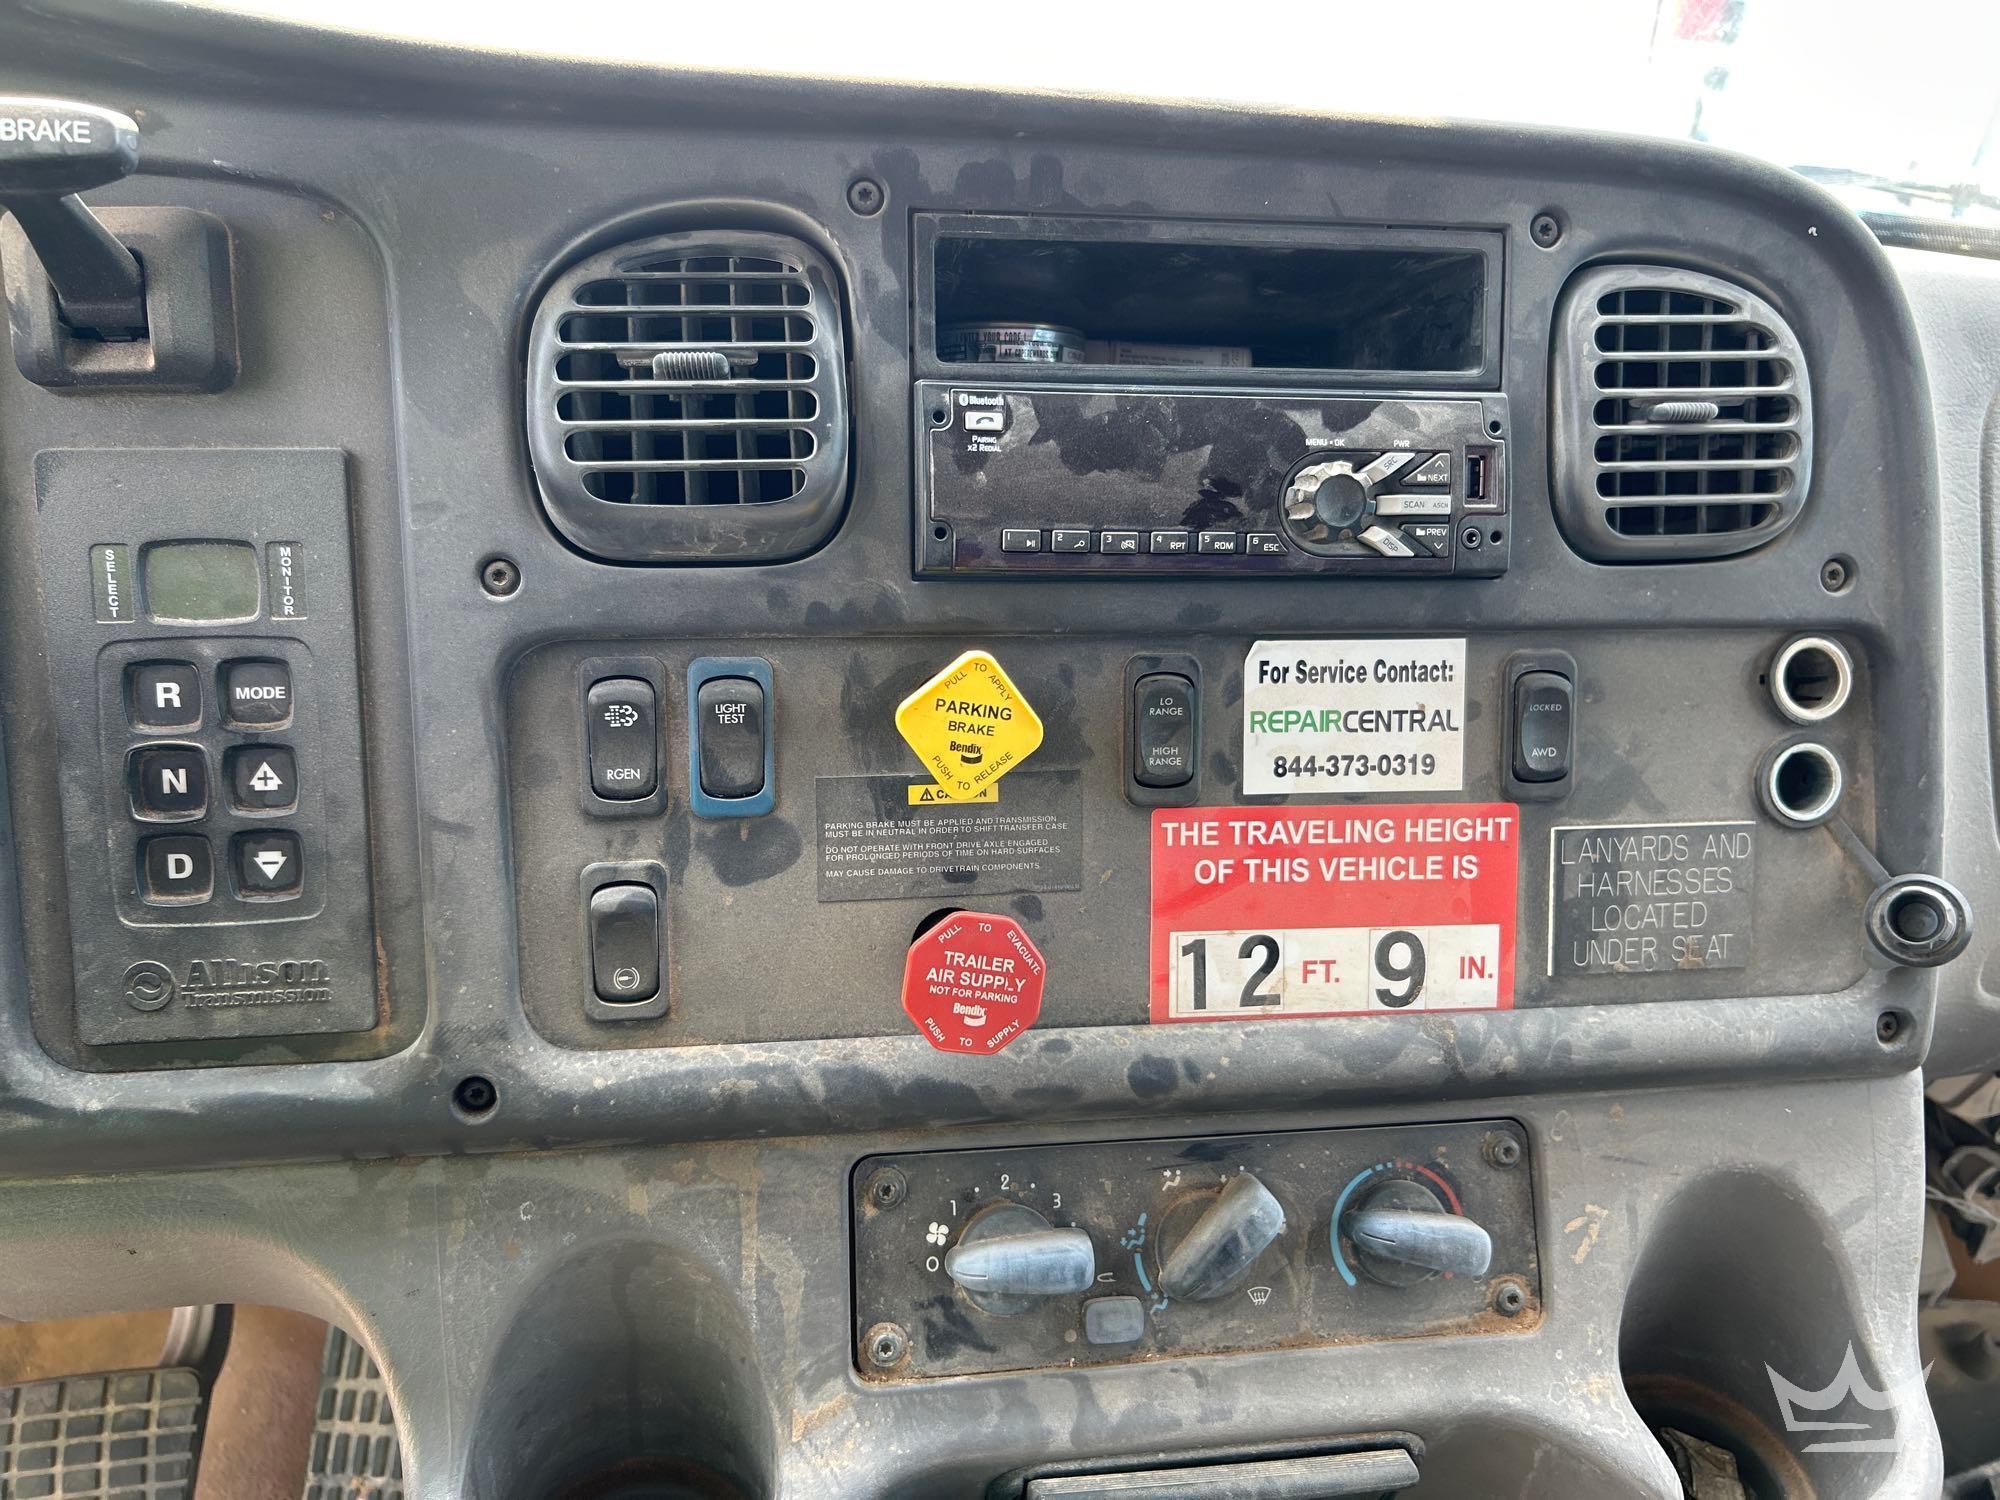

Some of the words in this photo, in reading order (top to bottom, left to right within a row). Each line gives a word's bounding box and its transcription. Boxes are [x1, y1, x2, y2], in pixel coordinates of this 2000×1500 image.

[0, 118, 91, 143] BRAKE
[1305, 438, 1327, 446] MENU
[1393, 440, 1410, 448] PWR
[1383, 456, 1398, 470] SRC
[1427, 474, 1448, 482] NEXT
[1404, 501, 1425, 509] SCAN
[1106, 535, 1112, 543] 3
[1426, 528, 1447, 536] PREV
[1156, 535, 1162, 543] 4
[1170, 542, 1186, 550] RPT
[1204, 535, 1210, 543] 5
[1214, 542, 1234, 550] RDM
[1252, 537, 1259, 545] 6
[1263, 543, 1279, 551] ESC
[1382, 538, 1398, 552] DISP
[105, 550, 119, 617] SELECT
[280, 547, 294, 615] MONITOR
[1259, 660, 1290, 684] For
[1295, 659, 1367, 684] Service
[1373, 659, 1454, 683] Contact:
[944, 671, 967, 689] PULL
[973, 663, 988, 672] TO
[988, 674, 1013, 701] APPLY
[156, 683, 182, 708] R
[236, 686, 286, 700] MODE
[715, 703, 747, 714] LIGHT
[935, 698, 1012, 721] PARKING
[1160, 697, 1173, 706] LO
[1529, 703, 1562, 711] LOCKED
[718, 714, 745, 724] TEST
[1149, 707, 1183, 716] RANGE
[948, 721, 995, 737] BRAKE
[1250, 709, 1459, 733] REPAIRCENTRAL
[950, 741, 982, 755] Bendix
[1153, 747, 1178, 756] HIGH
[1531, 747, 1557, 757] AWD
[1149, 757, 1182, 766] RANGE
[1273, 754, 1436, 778] 844-373-0319
[607, 769, 641, 780] RGEN
[932, 755, 954, 781] PUSH
[957, 781, 971, 791] TO
[974, 751, 1014, 784] RELEASE
[162, 769, 188, 794] N
[825, 822, 863, 830] PARKING
[866, 820, 895, 829] BRAKE
[898, 819, 921, 828] MUST
[924, 819, 935, 827] BE
[937, 818, 973, 826] APPLIED
[976, 817, 993, 825] AND
[995, 815, 1057, 824] TRANSMISSION
[825, 830, 849, 838] MUST
[851, 829, 863, 837] BE
[866, 828, 874, 836] IN
[877, 828, 915, 836] NEUTRAL
[918, 827, 927, 835] IN
[929, 826, 959, 834] ORDER
[961, 825, 972, 833] TO
[974, 824, 998, 832] SHIFT
[999, 823, 1044, 832] TRANSFER
[1045, 822, 1068, 830] CASE
[1161, 821, 1219, 847] THE
[1228, 819, 1395, 846] TRAVELING
[1405, 817, 1512, 843] HEIGHT
[825, 846, 838, 854] DO
[840, 845, 858, 853] NOT
[860, 844, 900, 853] OPERATE
[902, 843, 923, 851] WITH
[926, 842, 953, 850] FRONT
[956, 841, 981, 849] DRIVE
[983, 840, 1005, 848] AXLE
[1008, 839, 1048, 847] ENGAGED
[825, 854, 844, 862] FOR
[846, 852, 900, 861] PROLONGED
[902, 850, 940, 859] PERIODS
[942, 850, 953, 858] OF
[955, 849, 975, 857] TIME
[977, 848, 989, 856] ON
[991, 847, 1015, 855] HARD
[1017, 846, 1061, 854] SURFACES
[1561, 834, 1689, 865] LANYARDS
[1703, 832, 1753, 860] AND
[168, 854, 194, 880] D
[826, 870, 844, 878] MAY
[847, 868, 875, 877] CAUSE
[878, 867, 914, 876] DAMAGE
[916, 866, 928, 874] TO
[929, 864, 980, 874] DRIVETRAIN
[982, 862, 1040, 871] COMPONENTS
[1194, 859, 1234, 885] OF
[1244, 857, 1310, 883] THIS
[1319, 855, 1443, 881] VEHICLE
[1453, 855, 1479, 879] IS
[1578, 867, 1733, 898] HARNESSES
[1591, 901, 1708, 932] LOCATED
[938, 924, 962, 944] PULL
[978, 922, 992, 932] TO
[1006, 930, 1042, 976] EVACUATE
[1574, 936, 1657, 966] UNDER
[1672, 933, 1734, 962] SEAT
[944, 951, 1015, 973] TRAILER
[1302, 959, 1340, 984] FT.
[1374, 930, 1426, 1008] 9
[1459, 956, 1493, 980] IN.
[926, 968, 955, 984] AIR
[960, 972, 1026, 992] SUPPLY
[929, 985, 950, 994] NOT
[952, 988, 973, 998] FOR
[974, 991, 1018, 1004] PARKING
[953, 1003, 987, 1017] Bendix
[925, 1017, 946, 1043] PUSH
[959, 1037, 973, 1047] TO
[986, 1019, 1020, 1048] SUPPLY
[1001, 1174, 1010, 1190] 2
[950, 1200, 957, 1216] 1
[1053, 1193, 1061, 1208] 3
